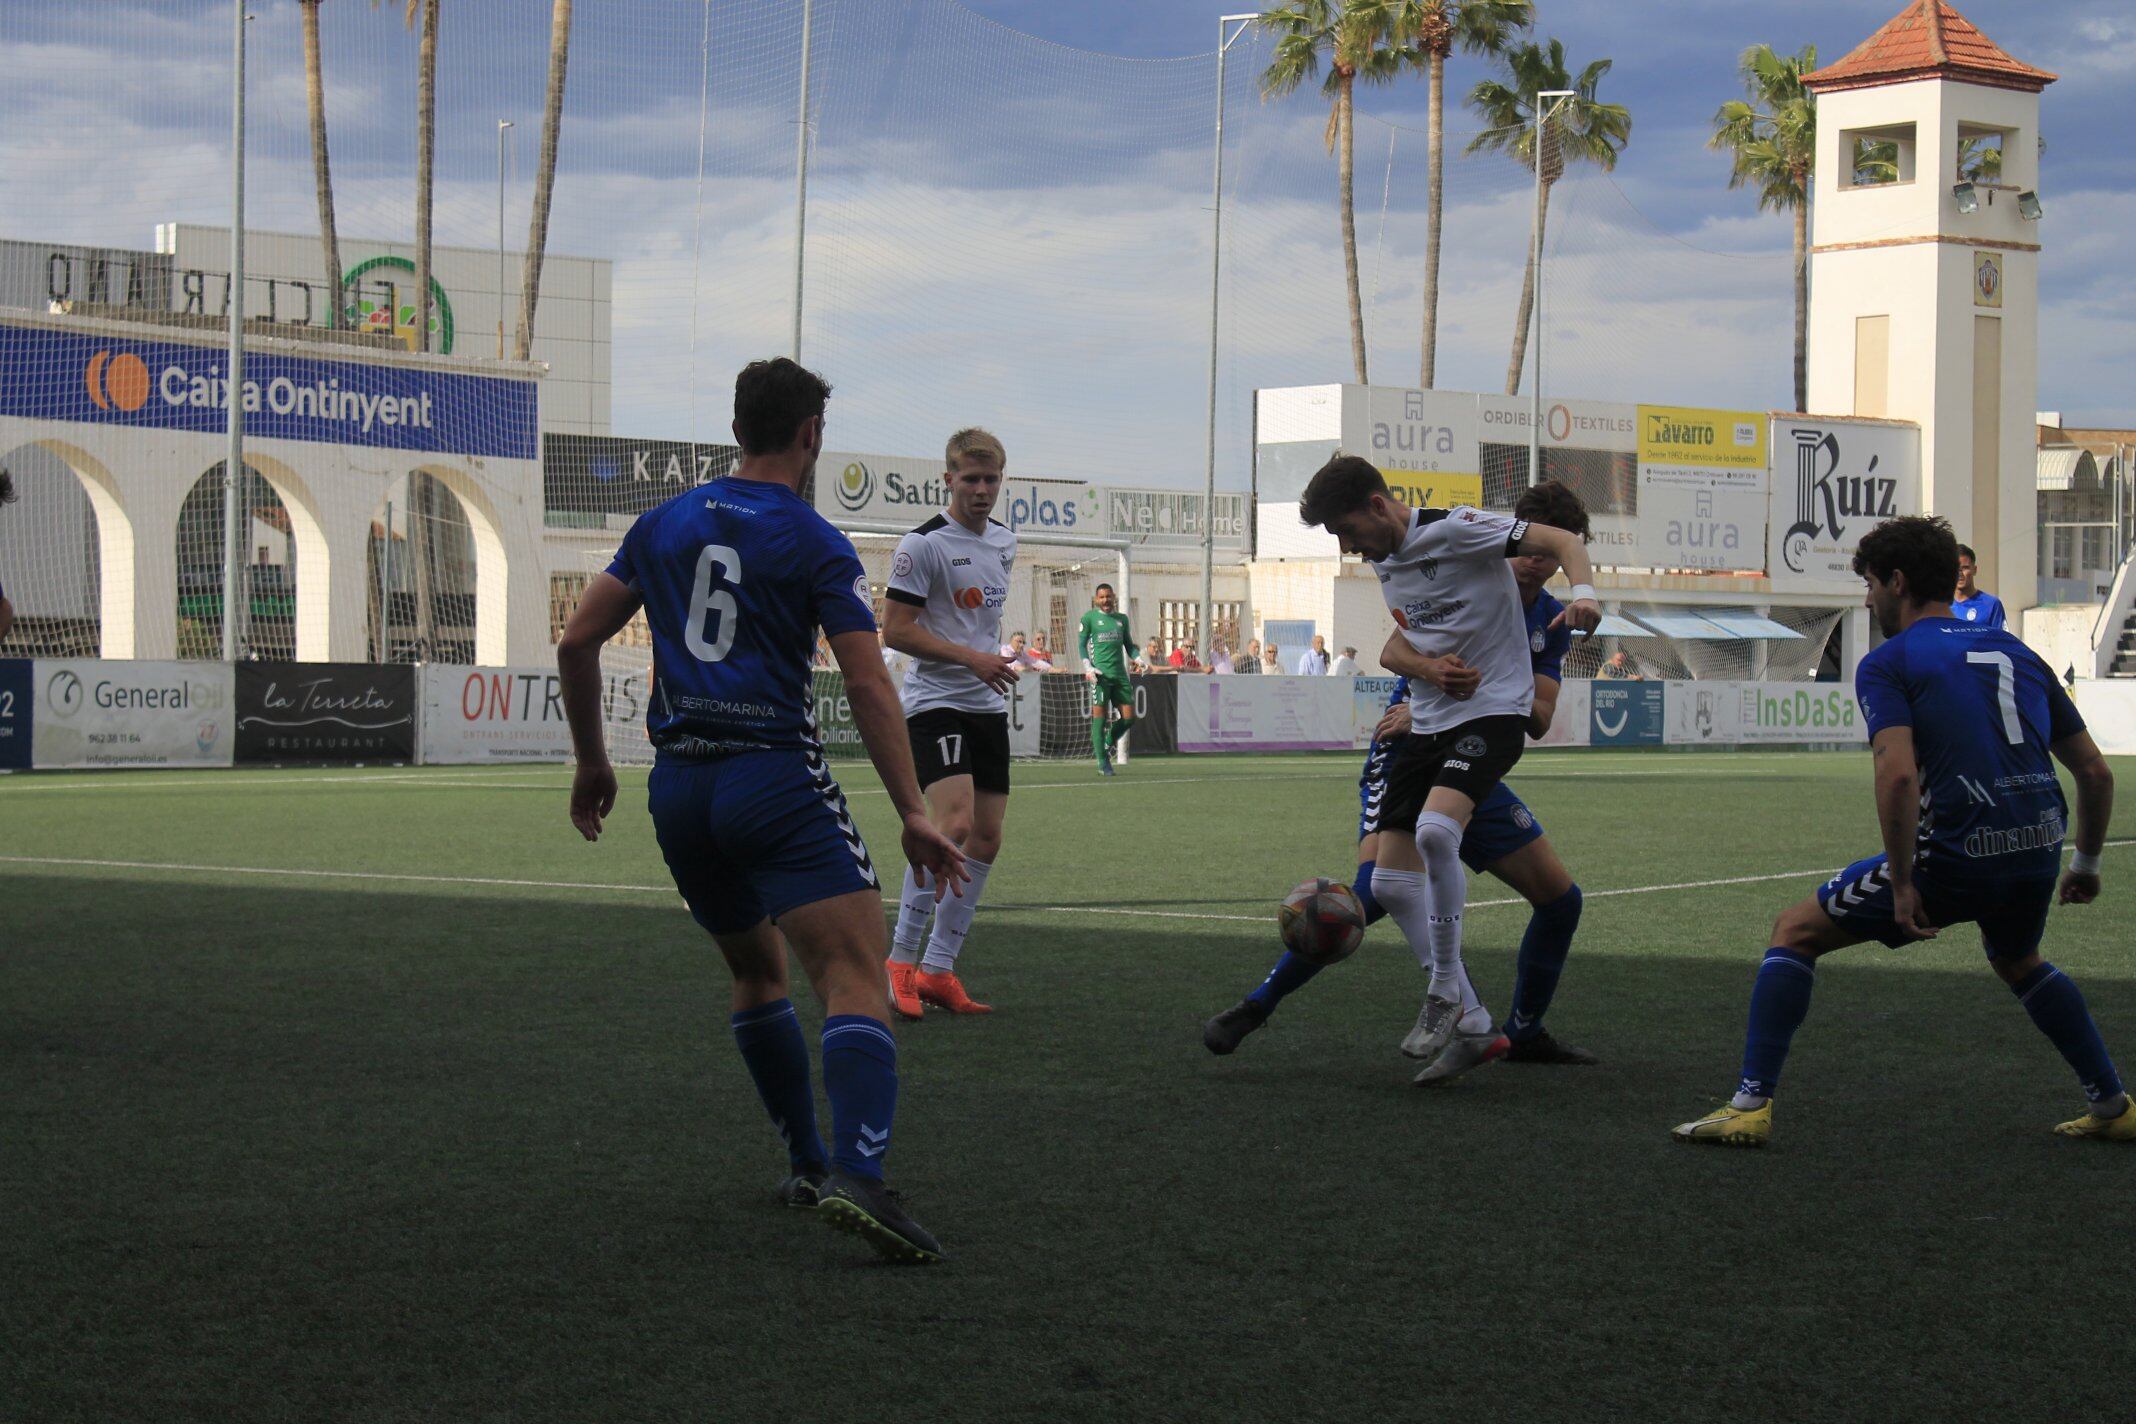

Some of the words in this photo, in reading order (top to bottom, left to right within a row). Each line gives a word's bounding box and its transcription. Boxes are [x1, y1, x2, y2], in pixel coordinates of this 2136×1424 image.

[160, 365, 261, 412] Caixa
[268, 375, 432, 433] Ontinyent
[1573, 416, 1633, 433] TEXTILES
[1372, 421, 1454, 453] aura
[1388, 456, 1439, 470] house
[1512, 520, 1529, 541] GIOS
[1586, 531, 1633, 545] XTILES
[1666, 519, 1739, 550] aura
[952, 557, 972, 567] GIOS
[1680, 552, 1725, 566] house
[685, 544, 741, 662] 6
[1405, 600, 1431, 616] Caixa
[1355, 681, 1381, 693] ALTEA
[462, 672, 639, 723] ONTRNS
[1966, 651, 2024, 745] 7
[1757, 688, 1854, 727] InsDaSa
[268, 738, 385, 748] RESTAURANT
[820, 725, 863, 744] biliaria
[935, 734, 962, 766] 17
[1444, 759, 1471, 771] GIOS
[1994, 772, 2058, 788] ALBERTOMAR
